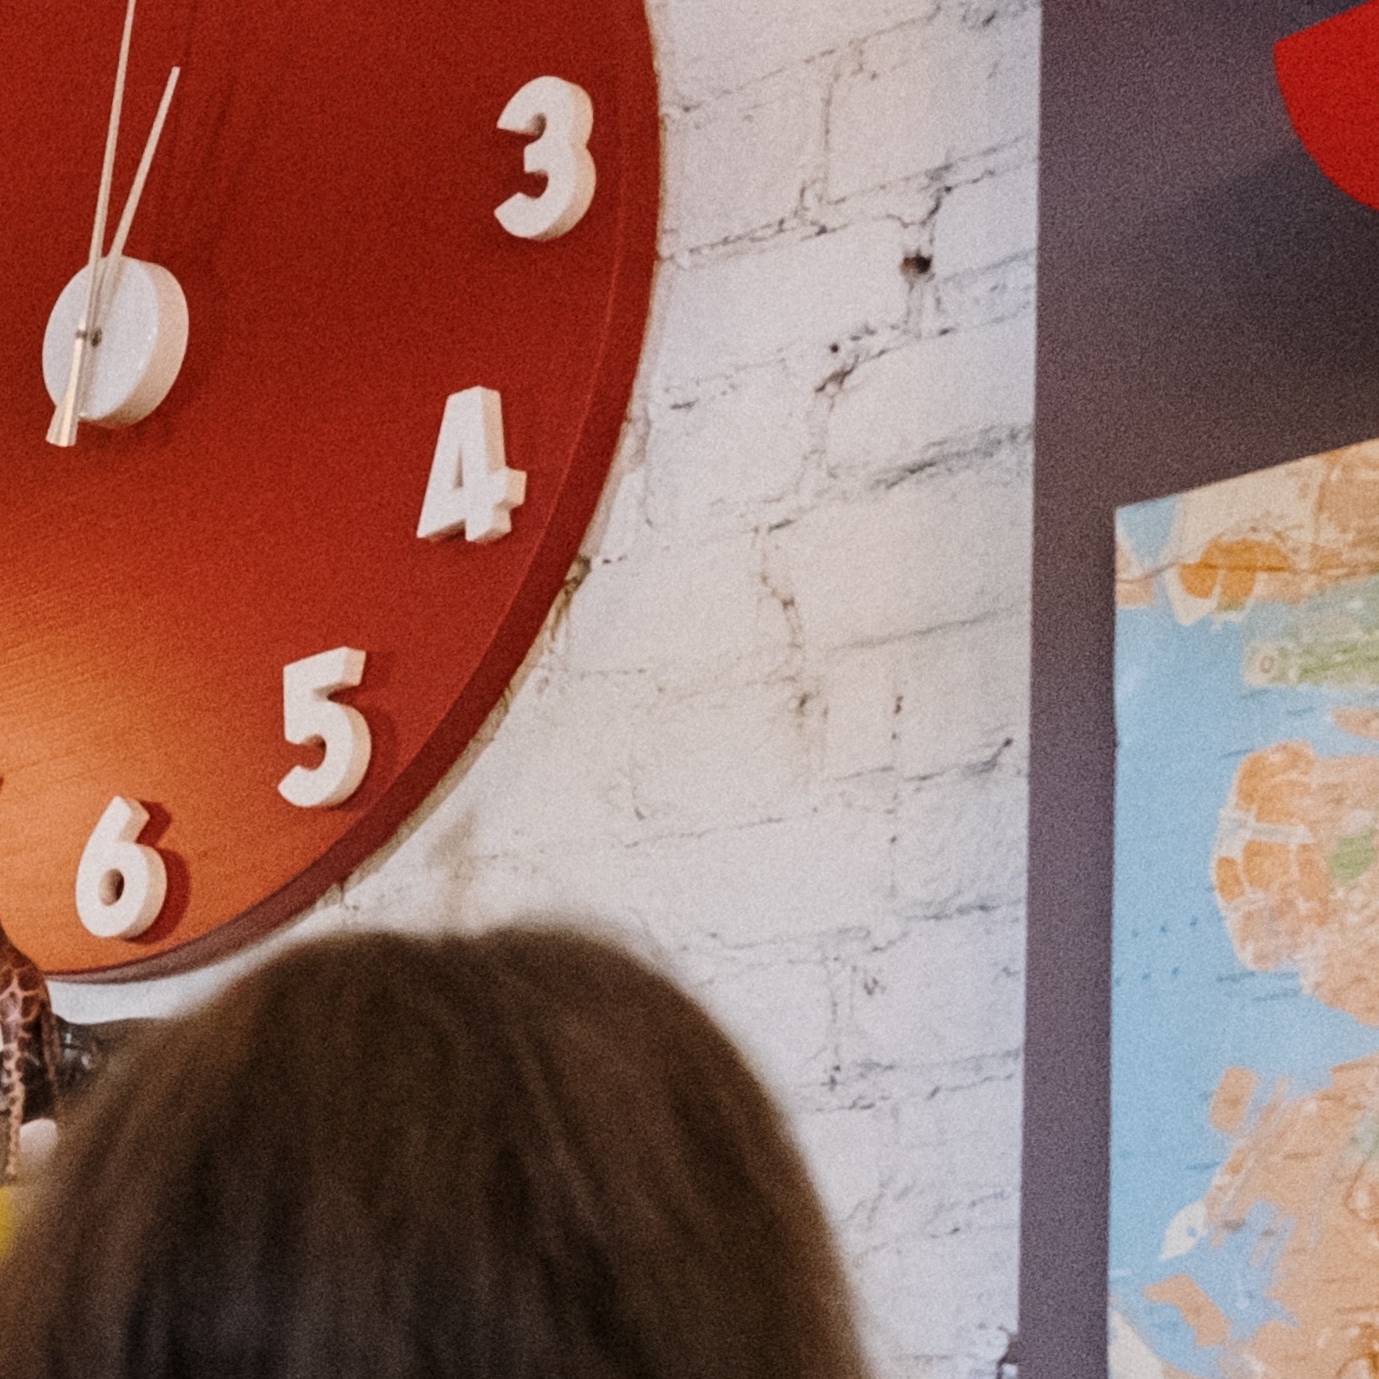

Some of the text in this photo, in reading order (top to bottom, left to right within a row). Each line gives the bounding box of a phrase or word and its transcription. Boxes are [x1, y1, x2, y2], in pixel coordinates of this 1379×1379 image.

[493, 75, 596, 240] 3
[417, 385, 527, 543] 4
[278, 646, 373, 808] 5
[75, 796, 167, 940] 6
